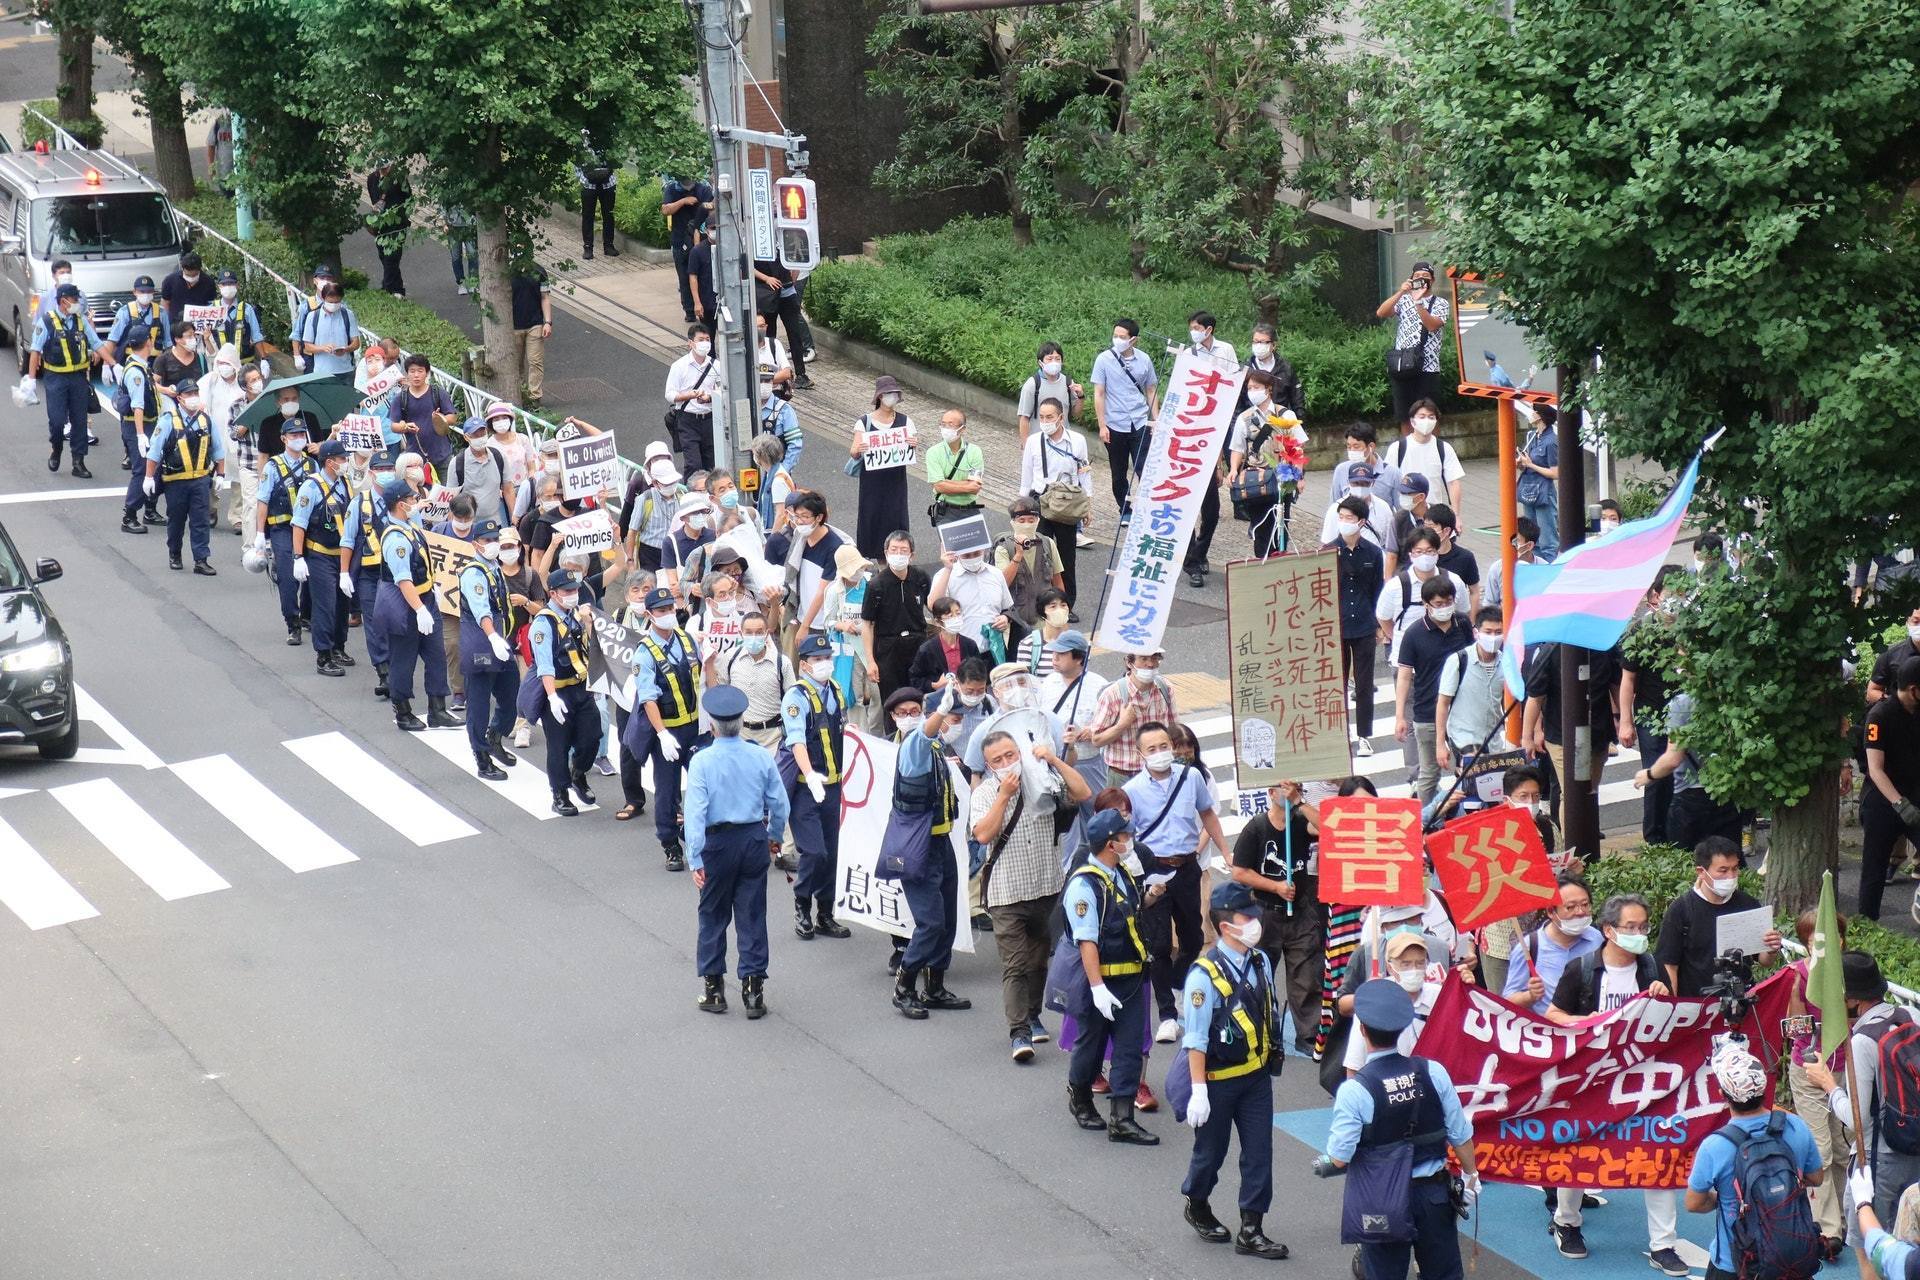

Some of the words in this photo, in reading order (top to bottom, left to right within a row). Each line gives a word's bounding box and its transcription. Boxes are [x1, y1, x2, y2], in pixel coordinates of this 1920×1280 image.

[366, 379, 388, 396] No
[341, 417, 376, 433] 中止だ!
[339, 432, 384, 449] 東京五輪
[567, 449, 579, 465] No
[865, 445, 915, 468] オリンピック
[565, 530, 613, 550] Olympics
[1283, 567, 1318, 754] すでに死に体
[1307, 566, 1346, 733] 東京五輪
[1867, 723, 1879, 742] 3
[1323, 802, 1417, 894] 害
[1446, 819, 1557, 925] 災
[1463, 990, 1587, 1058] JUST
[1499, 1118, 1547, 1141] NO
[1552, 1114, 1689, 1144] OLYMPICS
